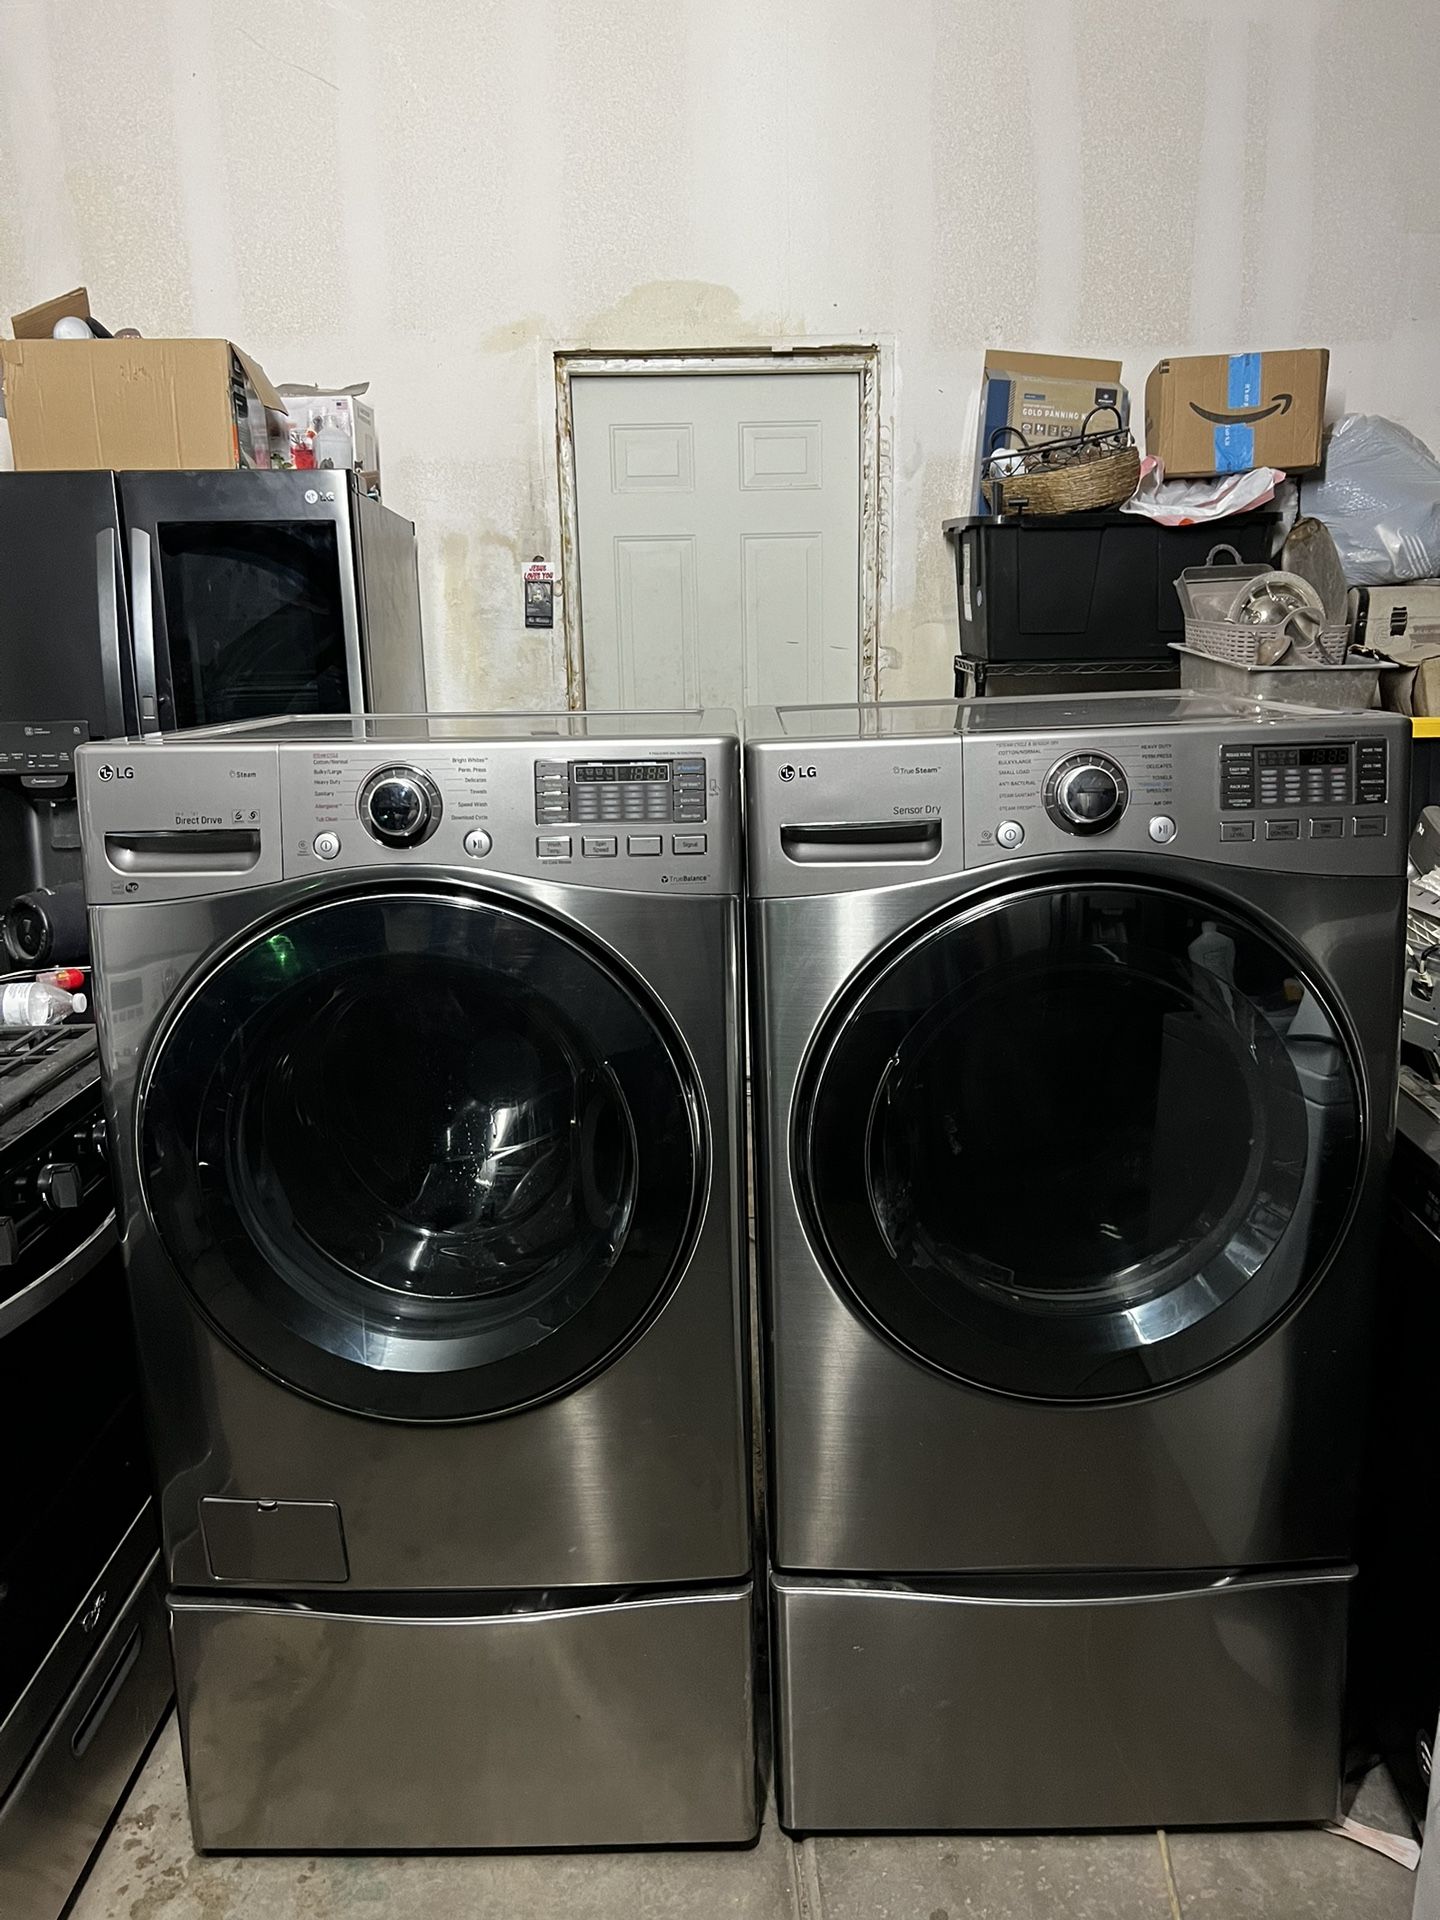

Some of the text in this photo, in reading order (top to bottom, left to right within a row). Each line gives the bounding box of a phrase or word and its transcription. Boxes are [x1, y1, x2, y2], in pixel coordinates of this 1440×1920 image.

[1022, 407, 1042, 417] GOLD
[1045, 410, 1079, 420] PANNING
[117, 767, 134, 779] LG
[799, 766, 817, 778] LG
[893, 804, 942, 815] Sensor Dry
[175, 815, 223, 825] Direct Drive
[682, 841, 699, 849] Signal
